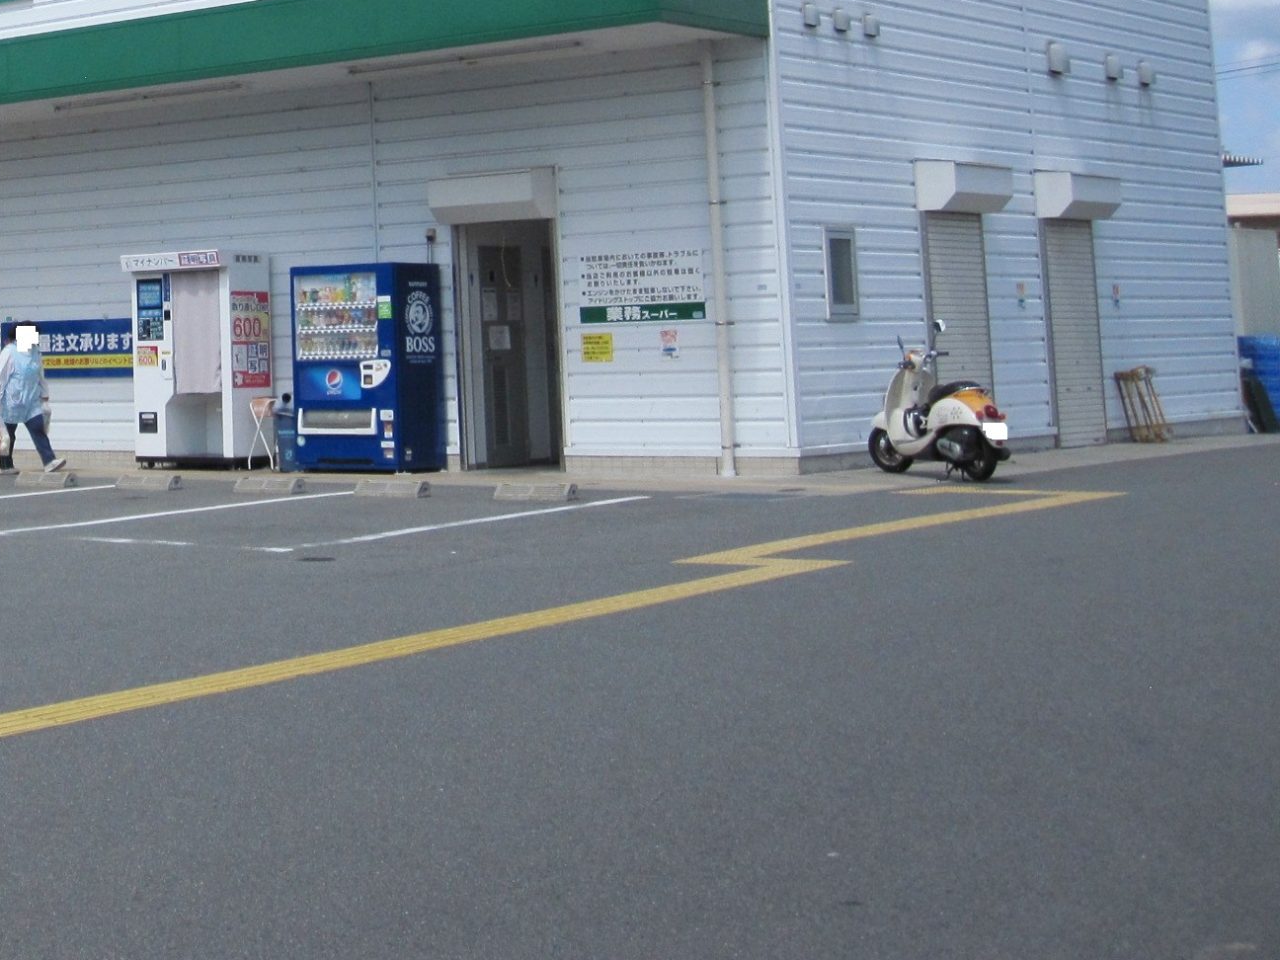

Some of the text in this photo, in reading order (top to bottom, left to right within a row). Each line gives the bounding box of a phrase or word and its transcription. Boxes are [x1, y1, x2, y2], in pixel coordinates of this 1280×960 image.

[131, 257, 173, 267] マイナンバー
[607, 306, 677, 321] 業務スーパー
[233, 317, 261, 338] 600
[405, 336, 435, 353] BOSS
